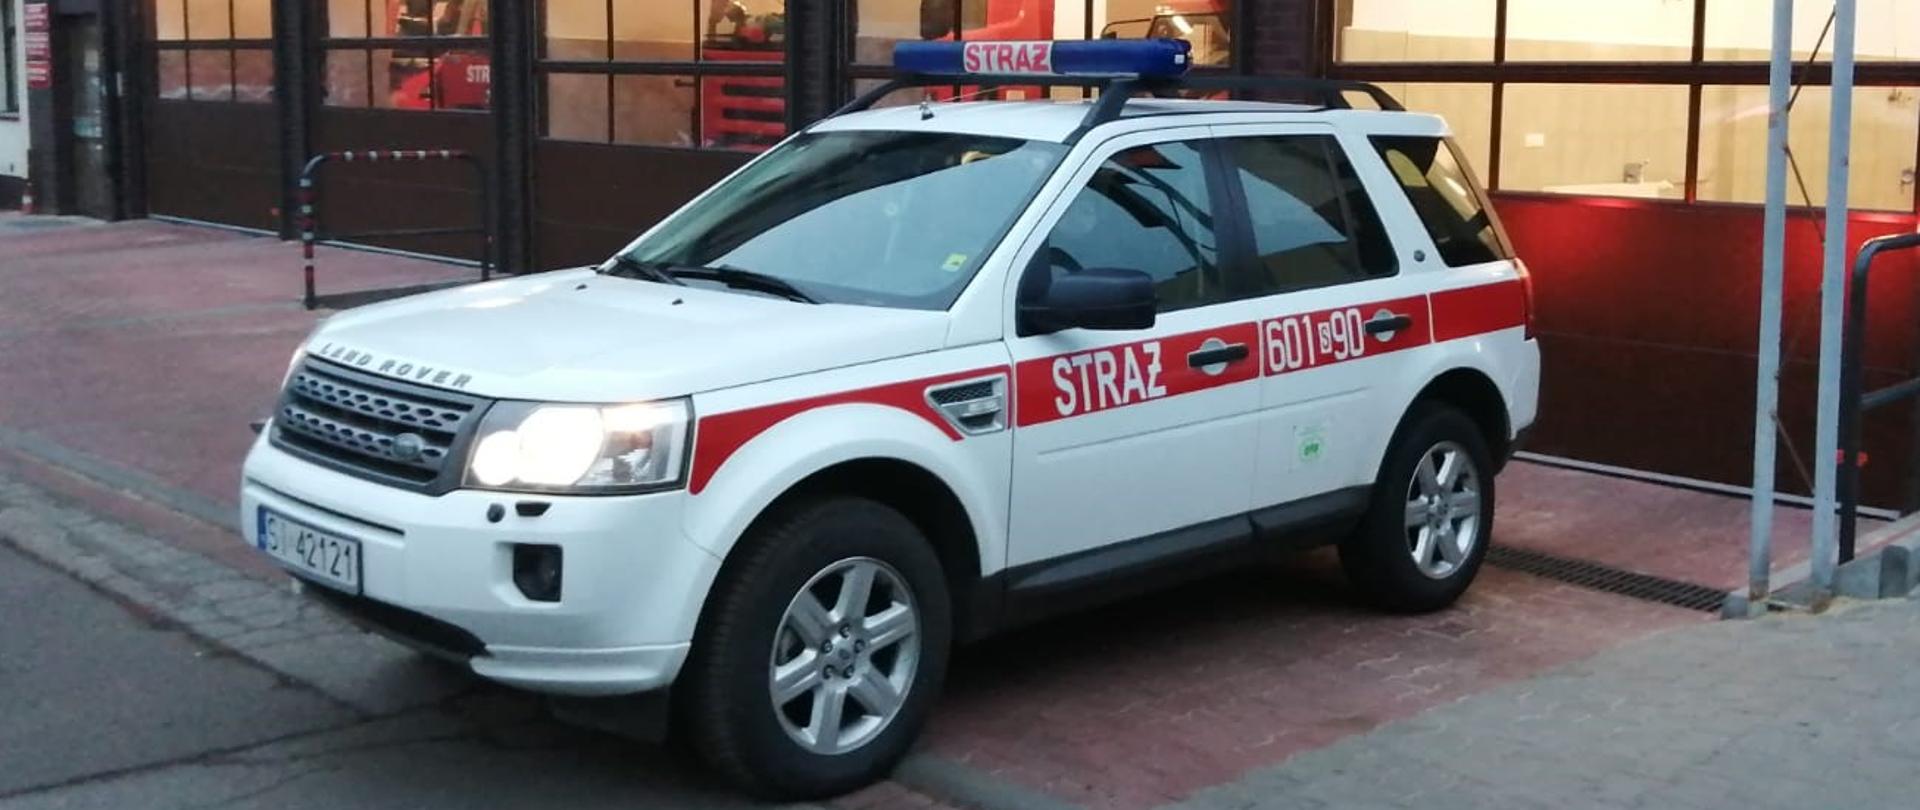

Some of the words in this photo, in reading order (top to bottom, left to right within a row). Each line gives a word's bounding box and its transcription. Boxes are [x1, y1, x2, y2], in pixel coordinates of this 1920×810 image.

[320, 342, 373, 366] LAND
[378, 359, 473, 388] ROVER
[295, 530, 353, 582] 42121
